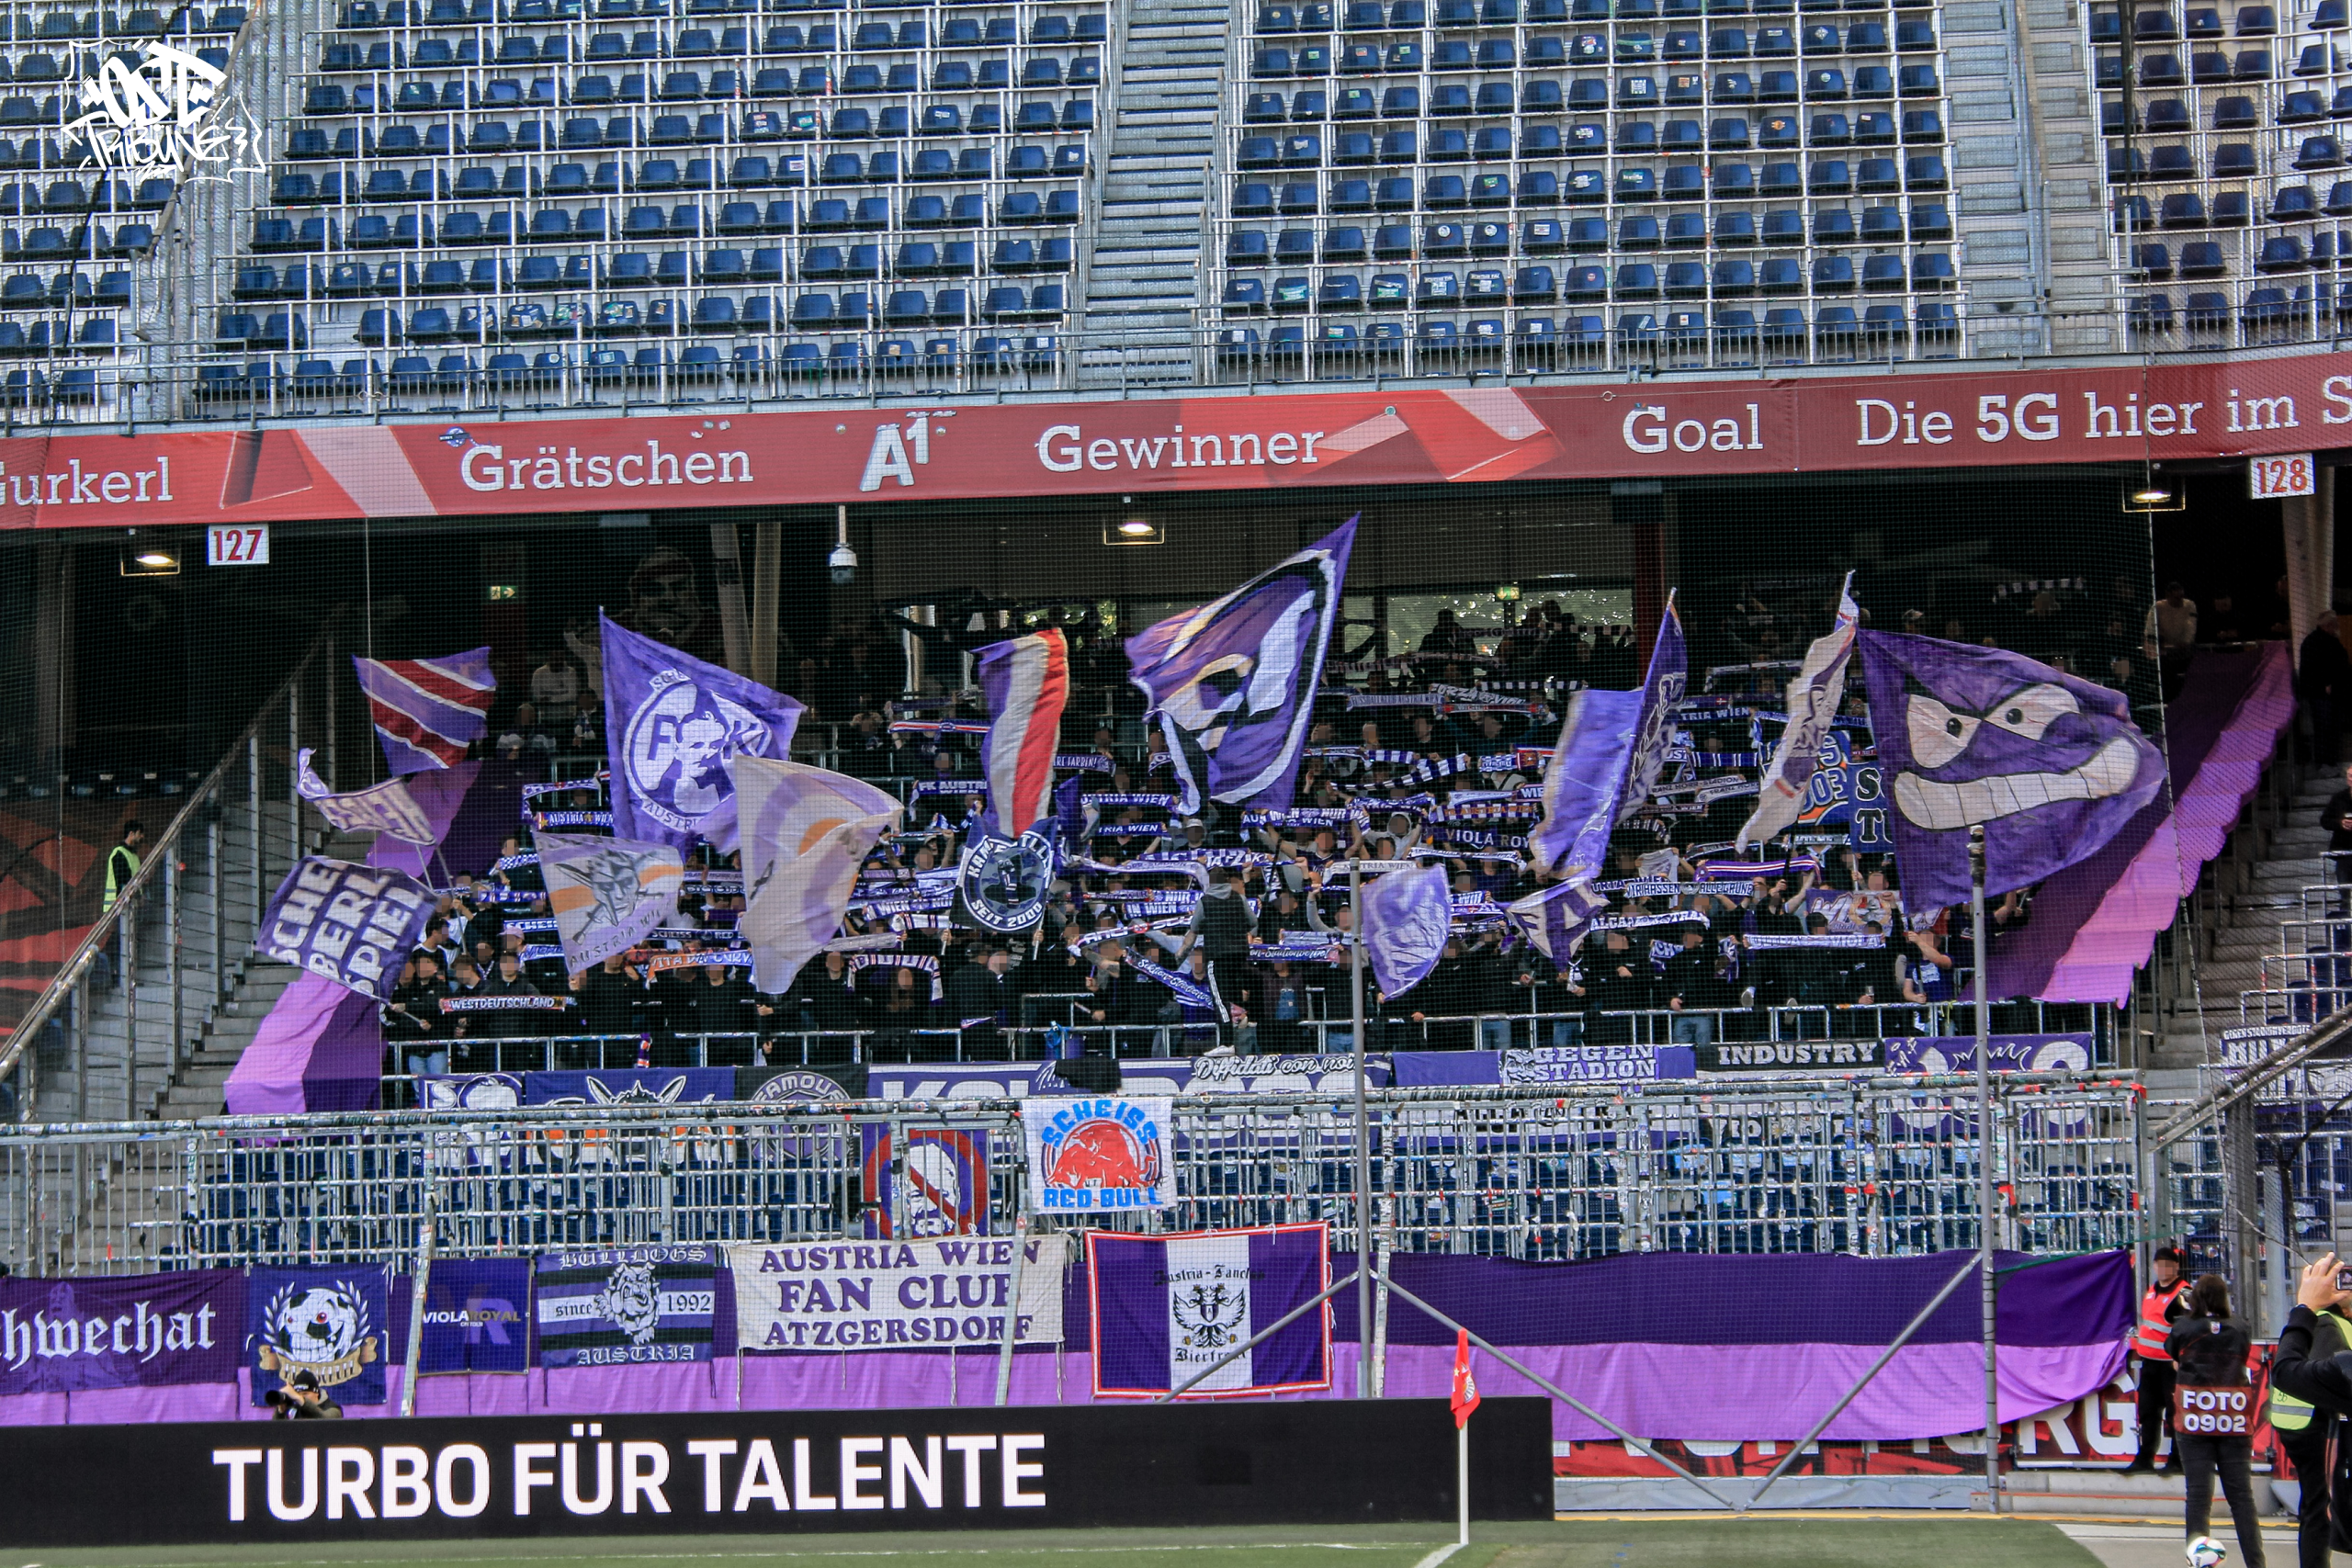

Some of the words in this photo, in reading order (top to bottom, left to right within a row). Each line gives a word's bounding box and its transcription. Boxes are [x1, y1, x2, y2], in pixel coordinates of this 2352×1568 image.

[1623, 402, 1764, 454] Goal
[1856, 398, 1954, 448] Die
[1976, 392, 2060, 444] 5G
[2086, 389, 2204, 439] hier
[2227, 387, 2300, 434] im
[860, 413, 931, 492] A1
[1037, 423, 1325, 474] Gewinner
[460, 438, 755, 493] Grätschen
[2256, 458, 2308, 497] 128
[211, 526, 264, 564] 127
[1716, 706, 1749, 718] WIEN
[920, 782, 936, 790] FK
[1133, 793, 1170, 806] WIEN
[549, 812, 584, 824] AUSTRIA
[1128, 824, 1159, 833] WIEN
[1445, 829, 1494, 845] VIOLA
[1644, 882, 1680, 896] HASSEN
[971, 899, 1003, 926] SEIT
[1007, 901, 1043, 928] 2000
[449, 997, 555, 1010] WESTDEUTSCHLAND
[1533, 1044, 1655, 1064] GEGEN
[1718, 1042, 1878, 1066] INDUSTRY
[1533, 1059, 1657, 1082] STADION
[1041, 1100, 1159, 1149] SCHEISS
[560, 1247, 707, 1269] BULLDOGS
[760, 1244, 920, 1272] AUSTRIA
[936, 1239, 1042, 1267] WIEN
[556, 1301, 593, 1317] since
[667, 1293, 712, 1314] 1992
[777, 1276, 874, 1313] FAN
[0, 1299, 217, 1372] hwechat
[578, 1345, 695, 1366] AUSTRIA
[2182, 1390, 2247, 1411] FOTO
[2184, 1414, 2246, 1434] 0902
[213, 1442, 490, 1522] TURBO
[515, 1423, 671, 1517] FÜR
[688, 1434, 1046, 1513] TALENTE
